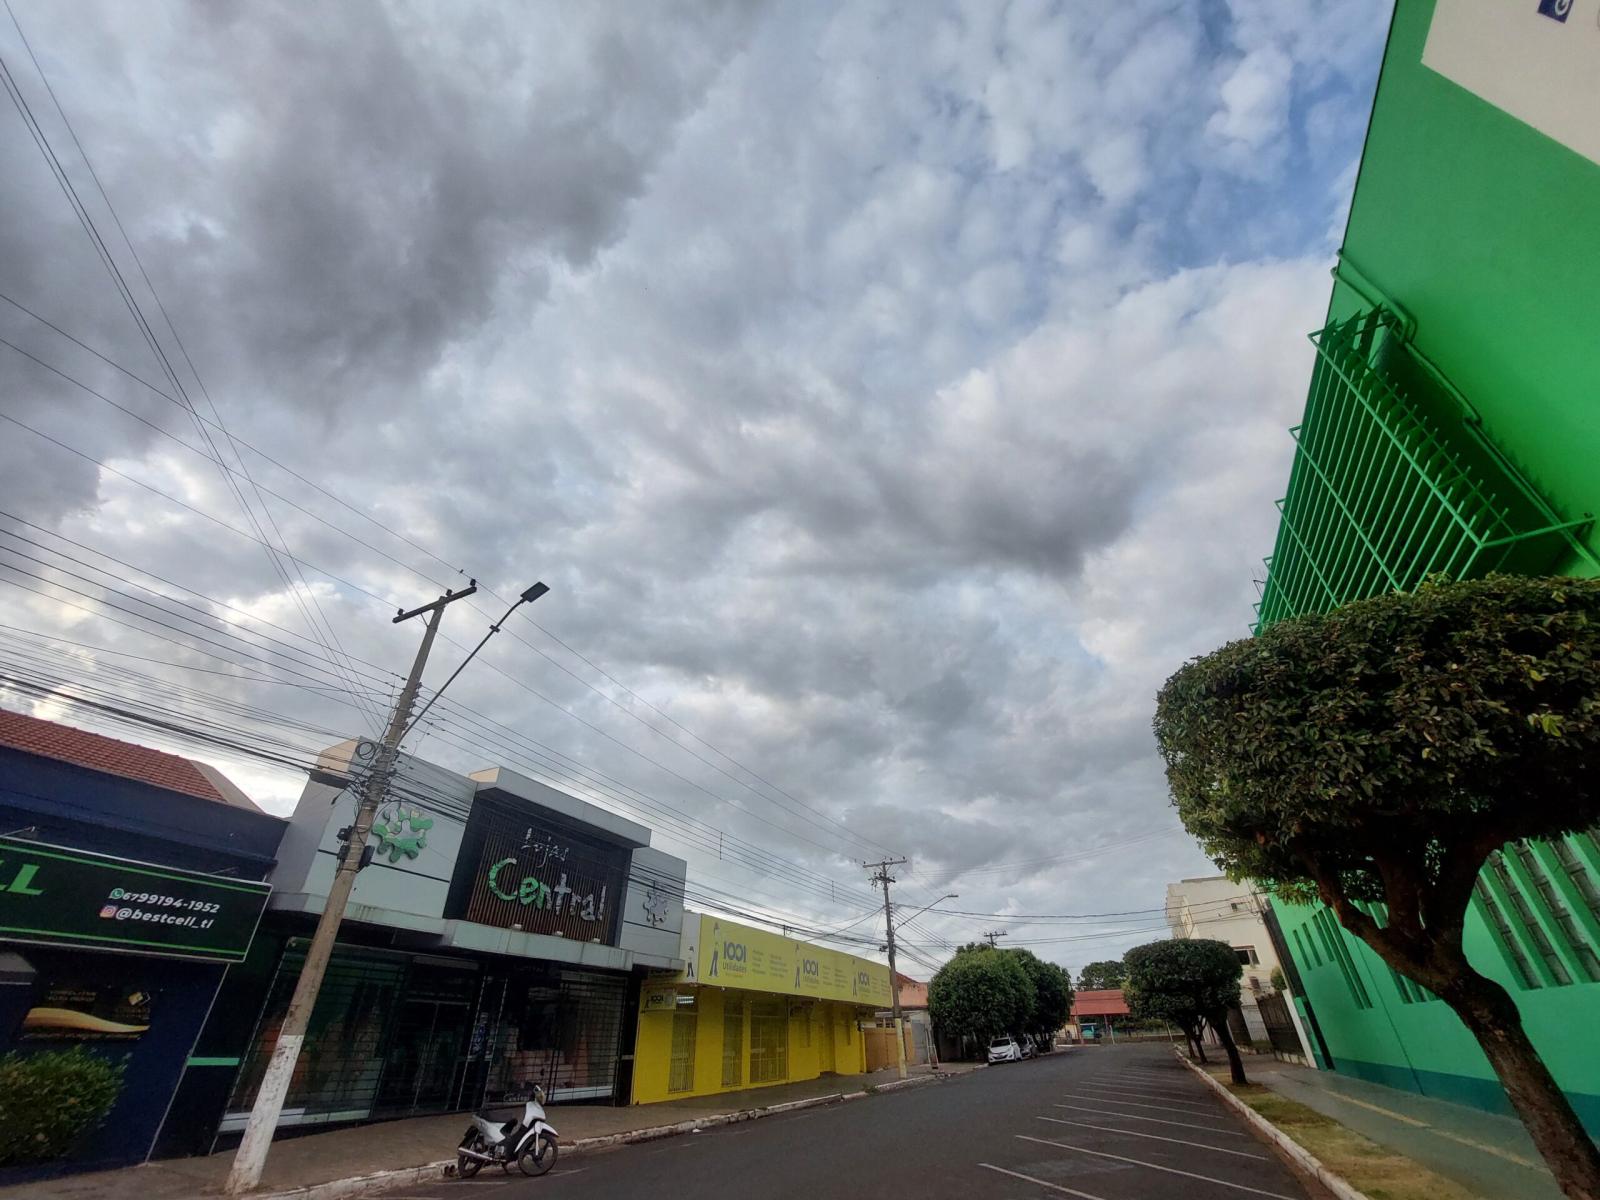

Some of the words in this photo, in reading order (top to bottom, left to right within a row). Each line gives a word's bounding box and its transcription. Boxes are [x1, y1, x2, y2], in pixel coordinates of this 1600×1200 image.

[0, 859, 44, 896] L
[487, 857, 607, 921] Central
[122, 892, 220, 913] 6799194-1952
[115, 908, 214, 928] @bestcell_tl
[723, 941, 747, 963] 1001
[803, 958, 819, 977] 1001
[857, 971, 871, 986] 1001
